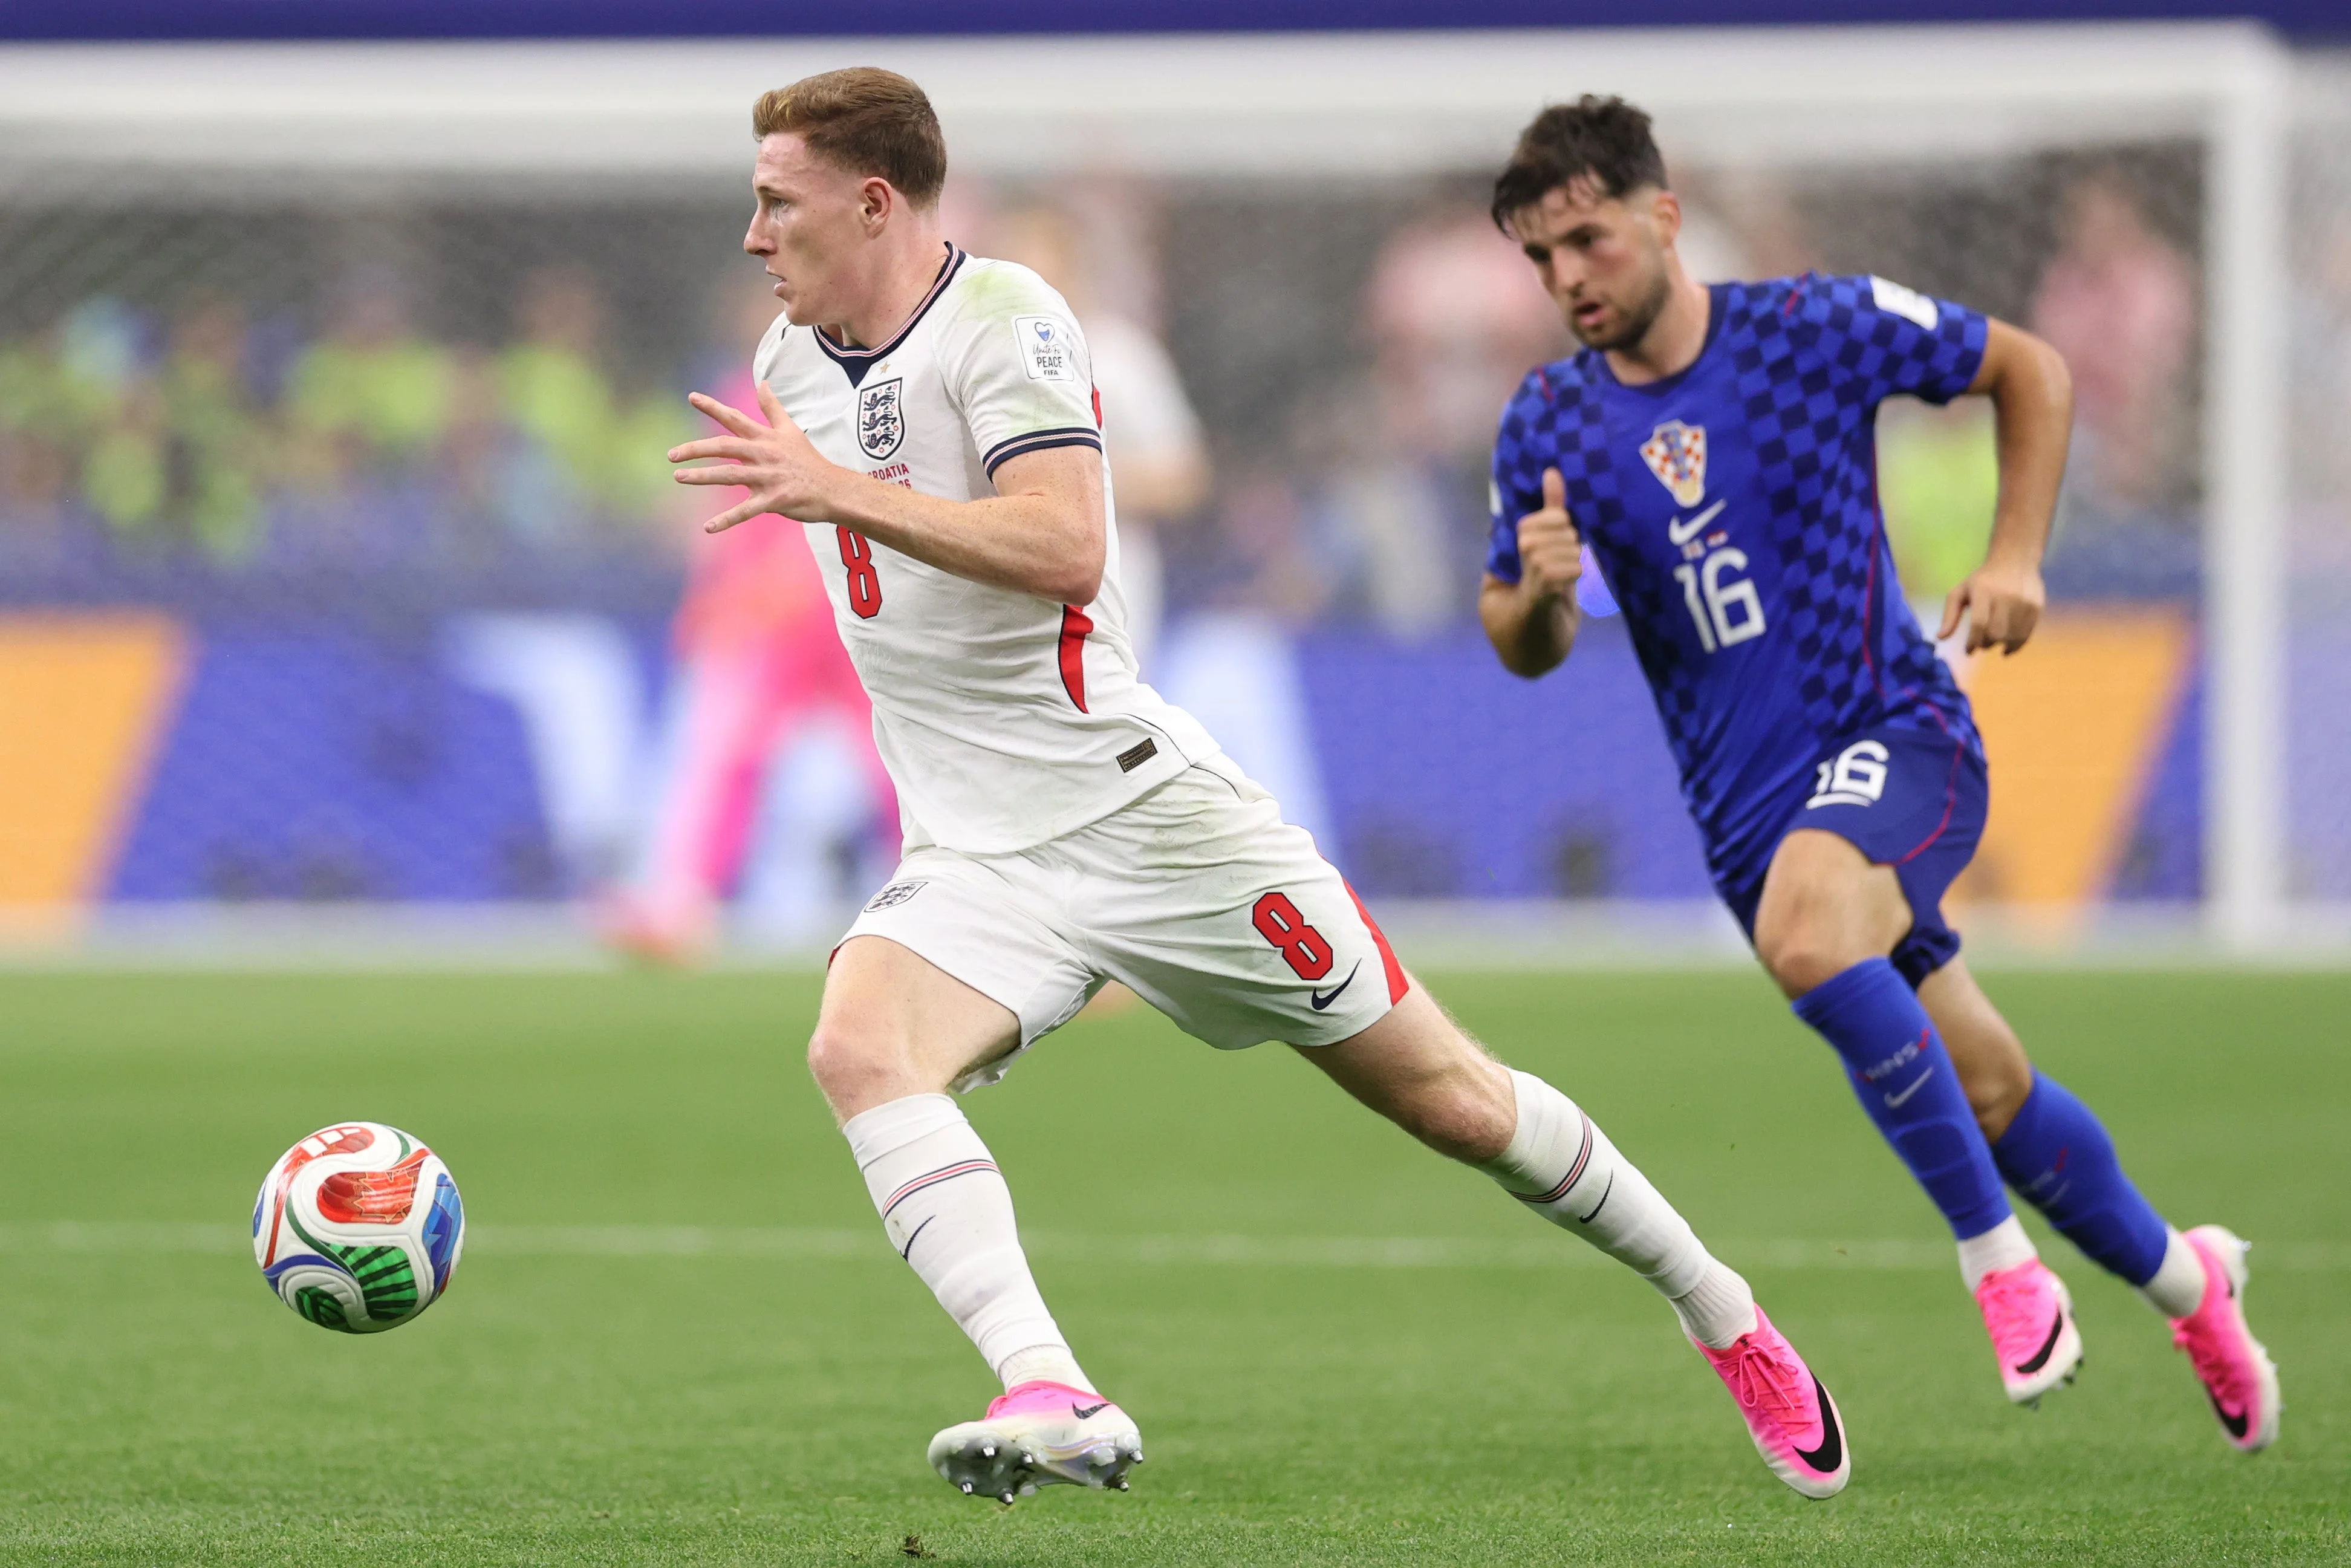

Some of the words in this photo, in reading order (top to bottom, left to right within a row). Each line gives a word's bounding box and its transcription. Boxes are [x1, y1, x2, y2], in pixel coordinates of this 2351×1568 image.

[1036, 356, 1062, 368] PEACE
[836, 525, 882, 619] 8
[1673, 547, 1767, 653] 16
[1805, 740, 1890, 810] 16
[1252, 893, 1333, 980] 8
